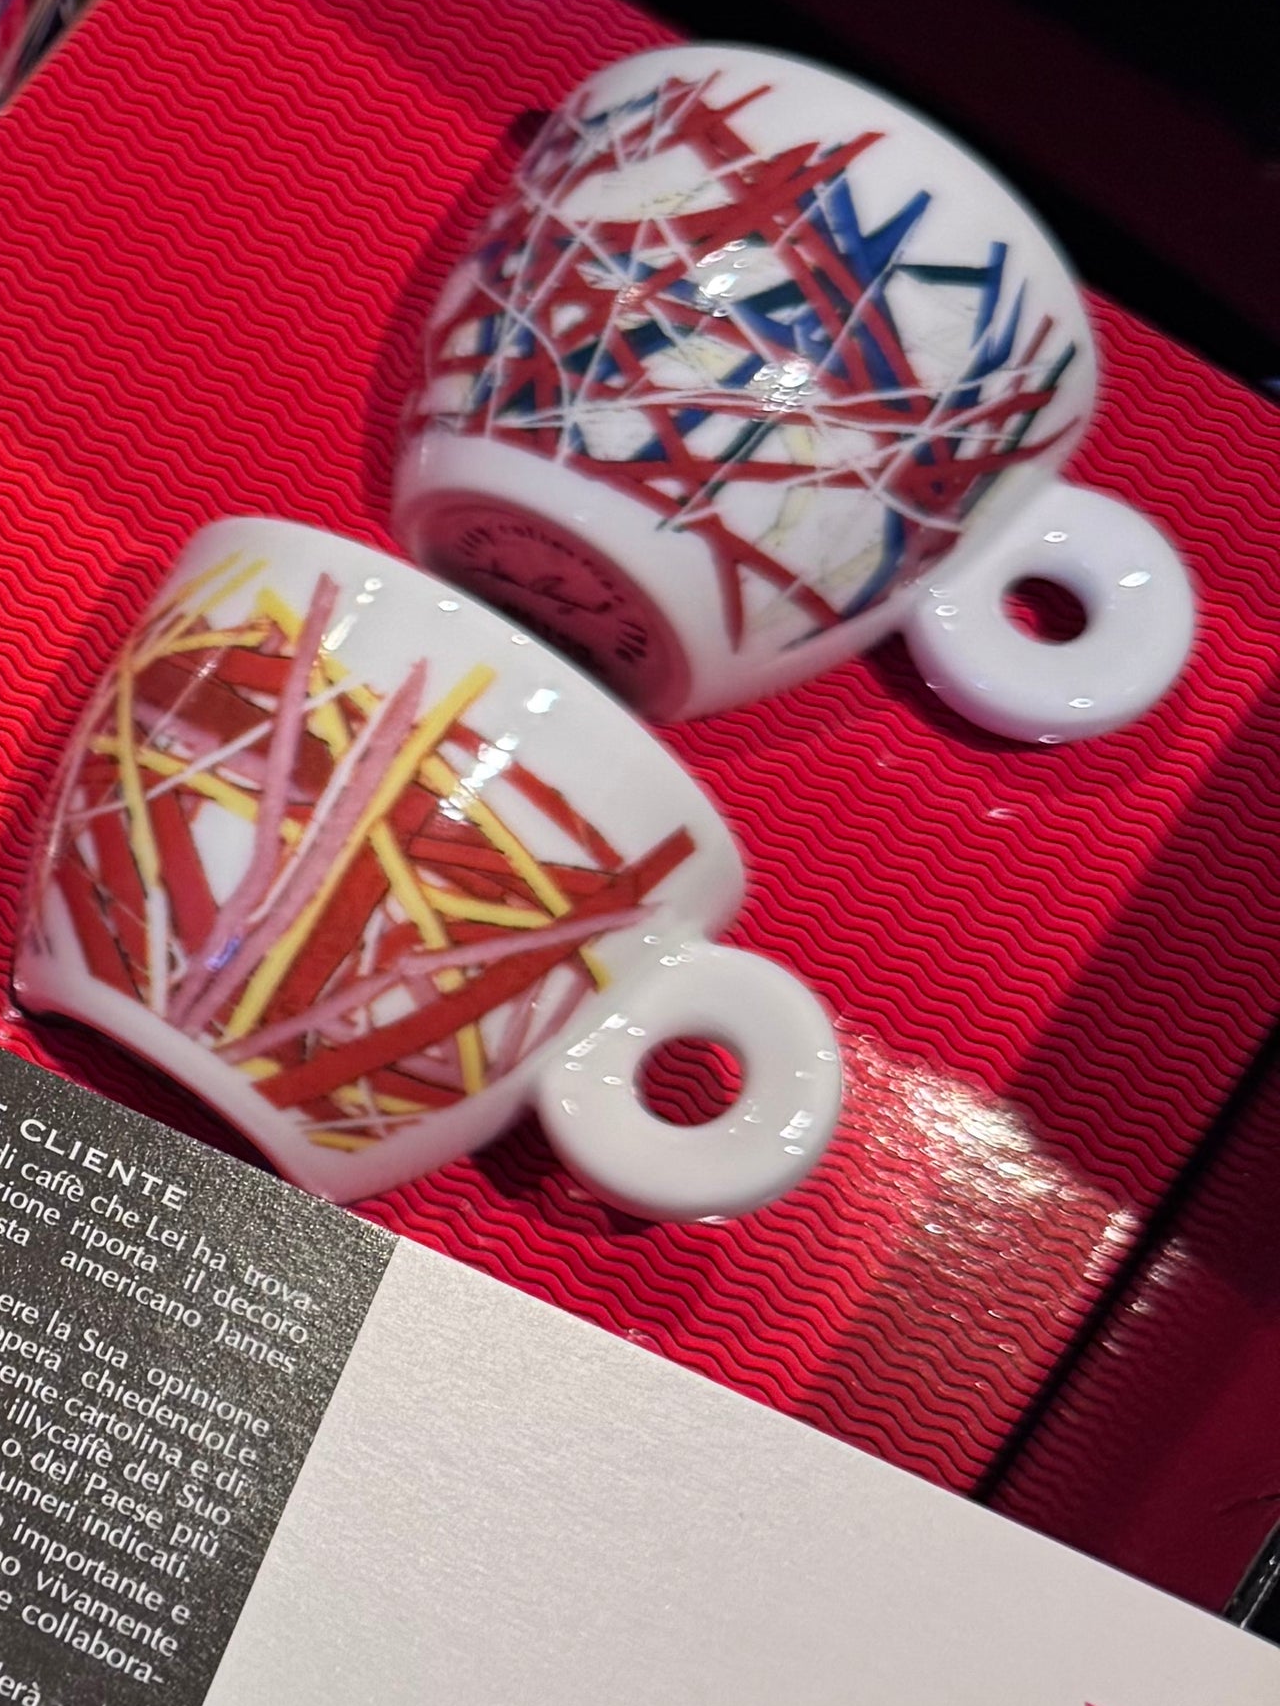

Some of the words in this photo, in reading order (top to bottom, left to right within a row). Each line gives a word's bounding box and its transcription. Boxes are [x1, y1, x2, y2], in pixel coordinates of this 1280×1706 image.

[19, 1118, 187, 1211] CLIENTE
[20, 1162, 84, 1202] caffè
[89, 1193, 140, 1228] che
[144, 1214, 188, 1251] Lei
[191, 1234, 227, 1271] ha
[243, 1263, 327, 1311] trova-
[59, 1249, 201, 1327] americano
[215, 1318, 296, 1374] James
[6, 1397, 113, 1467] illycaffè
[122, 1458, 170, 1494] del
[175, 1483, 231, 1526] Suo
[21, 1604, 163, 1683] collabora-
[36, 1570, 178, 1656] vivamente
